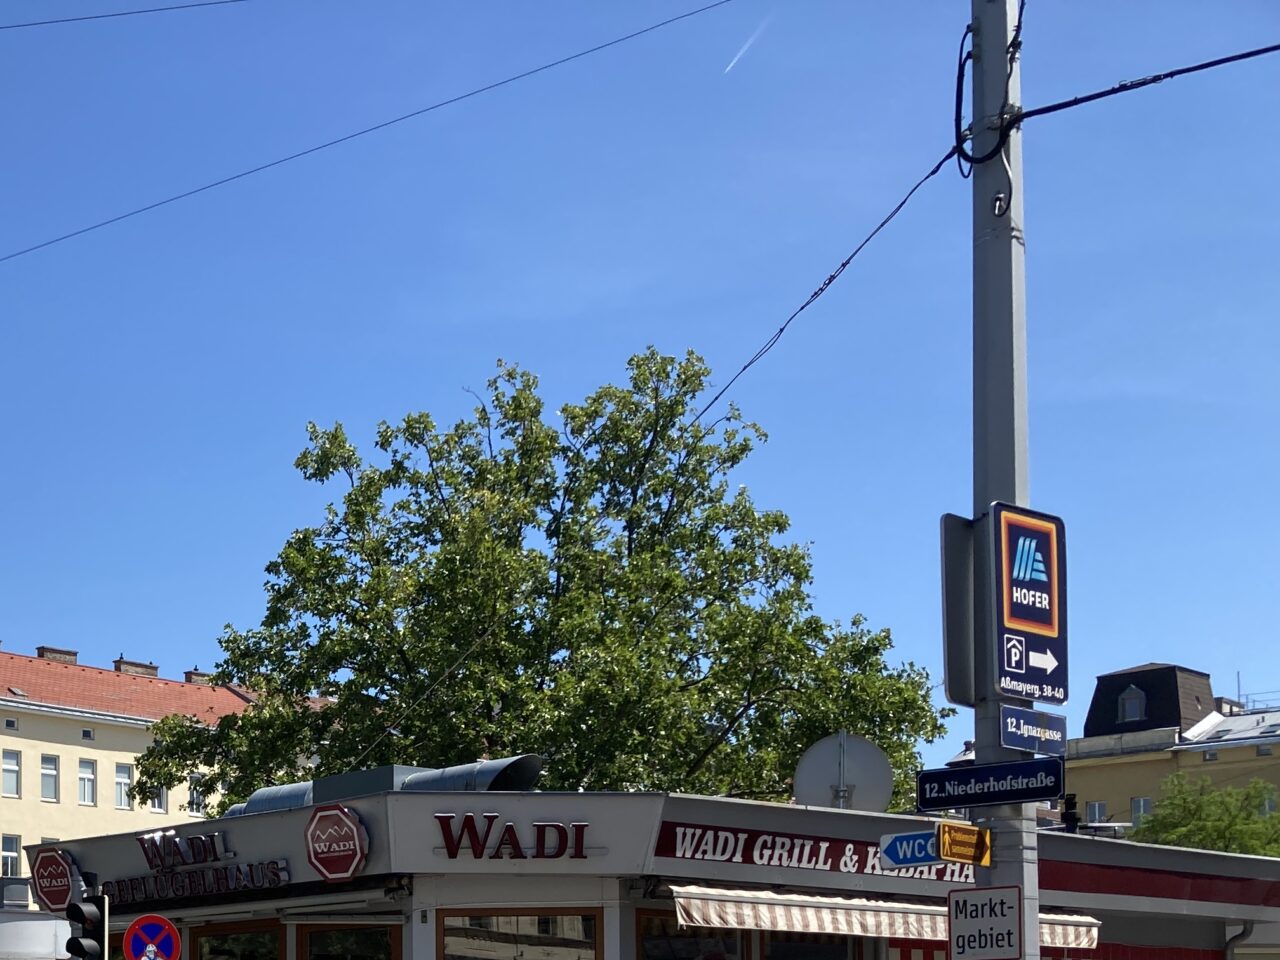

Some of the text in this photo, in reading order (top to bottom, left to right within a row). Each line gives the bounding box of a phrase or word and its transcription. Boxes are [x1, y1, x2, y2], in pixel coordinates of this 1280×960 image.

[1013, 586, 1049, 609] HOFER
[1000, 676, 1064, 699] Aßmayerg. 38-40
[313, 841, 355, 853] WADI
[433, 812, 590, 859] WADI
[136, 829, 221, 870] WADI
[674, 826, 749, 862] WADI
[753, 834, 832, 870] GRILL
[839, 843, 859, 873] &
[896, 838, 926, 859] WC
[39, 878, 69, 887] WADI
[954, 898, 1014, 920] Markt-
[956, 927, 1014, 954] gebiet
